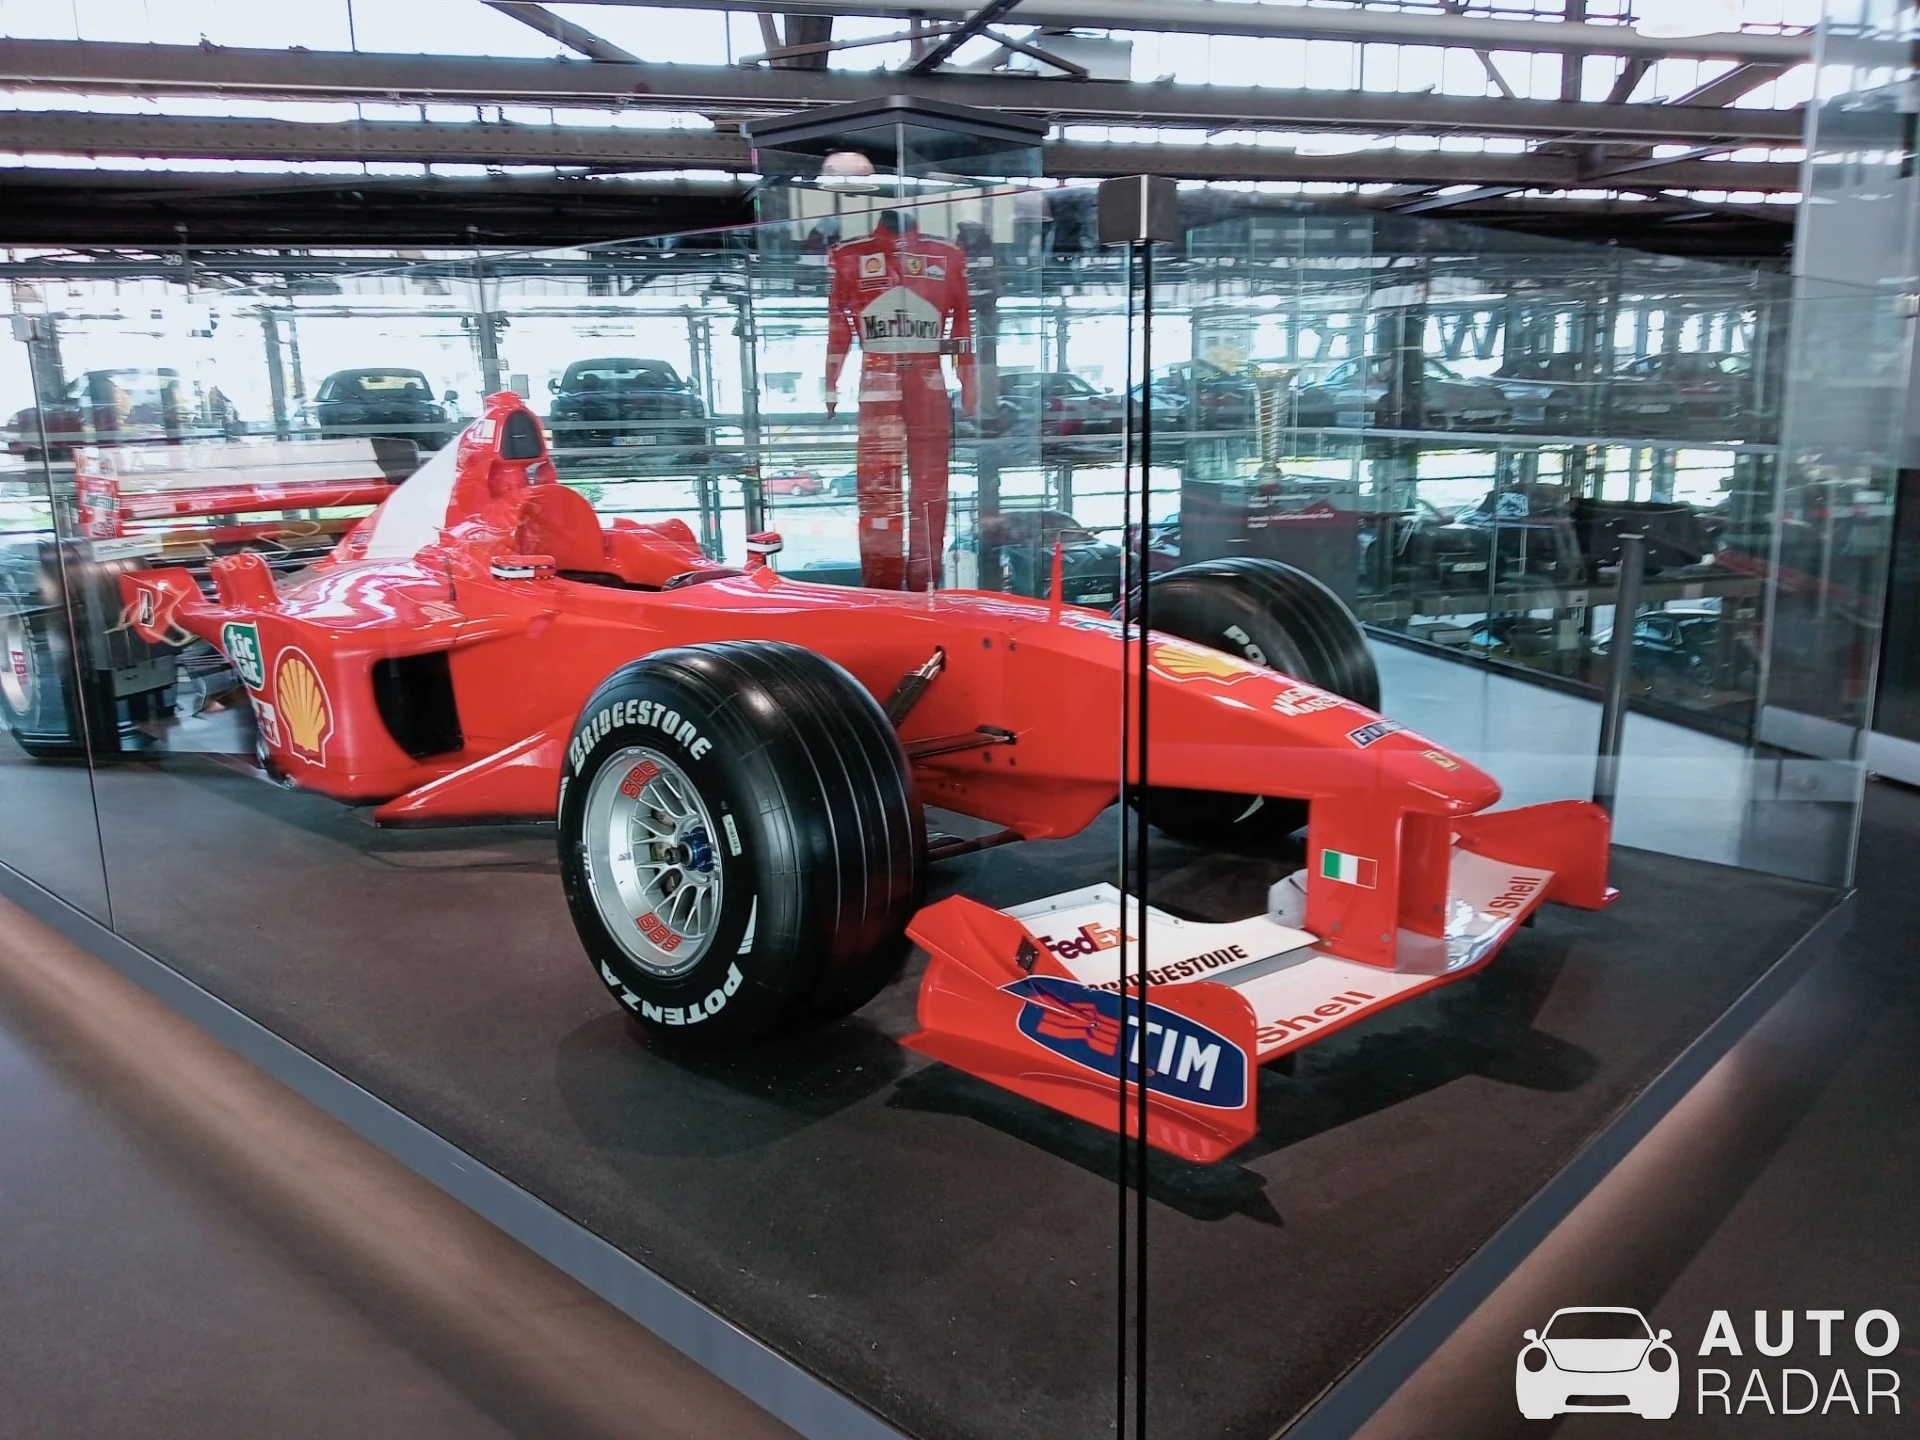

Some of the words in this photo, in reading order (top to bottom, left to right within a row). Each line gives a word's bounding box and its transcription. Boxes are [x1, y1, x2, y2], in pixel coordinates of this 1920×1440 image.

[228, 625, 256, 661] tic
[569, 699, 713, 777] BRIDGESTONE
[621, 760, 660, 799] BBS
[1489, 876, 1542, 909] Shell
[635, 911, 683, 953] BBS
[1036, 922, 1137, 960] FedEx
[601, 958, 744, 1026] POTENZA
[1255, 990, 1376, 1045] Shell
[1128, 1015, 1222, 1092] TIM
